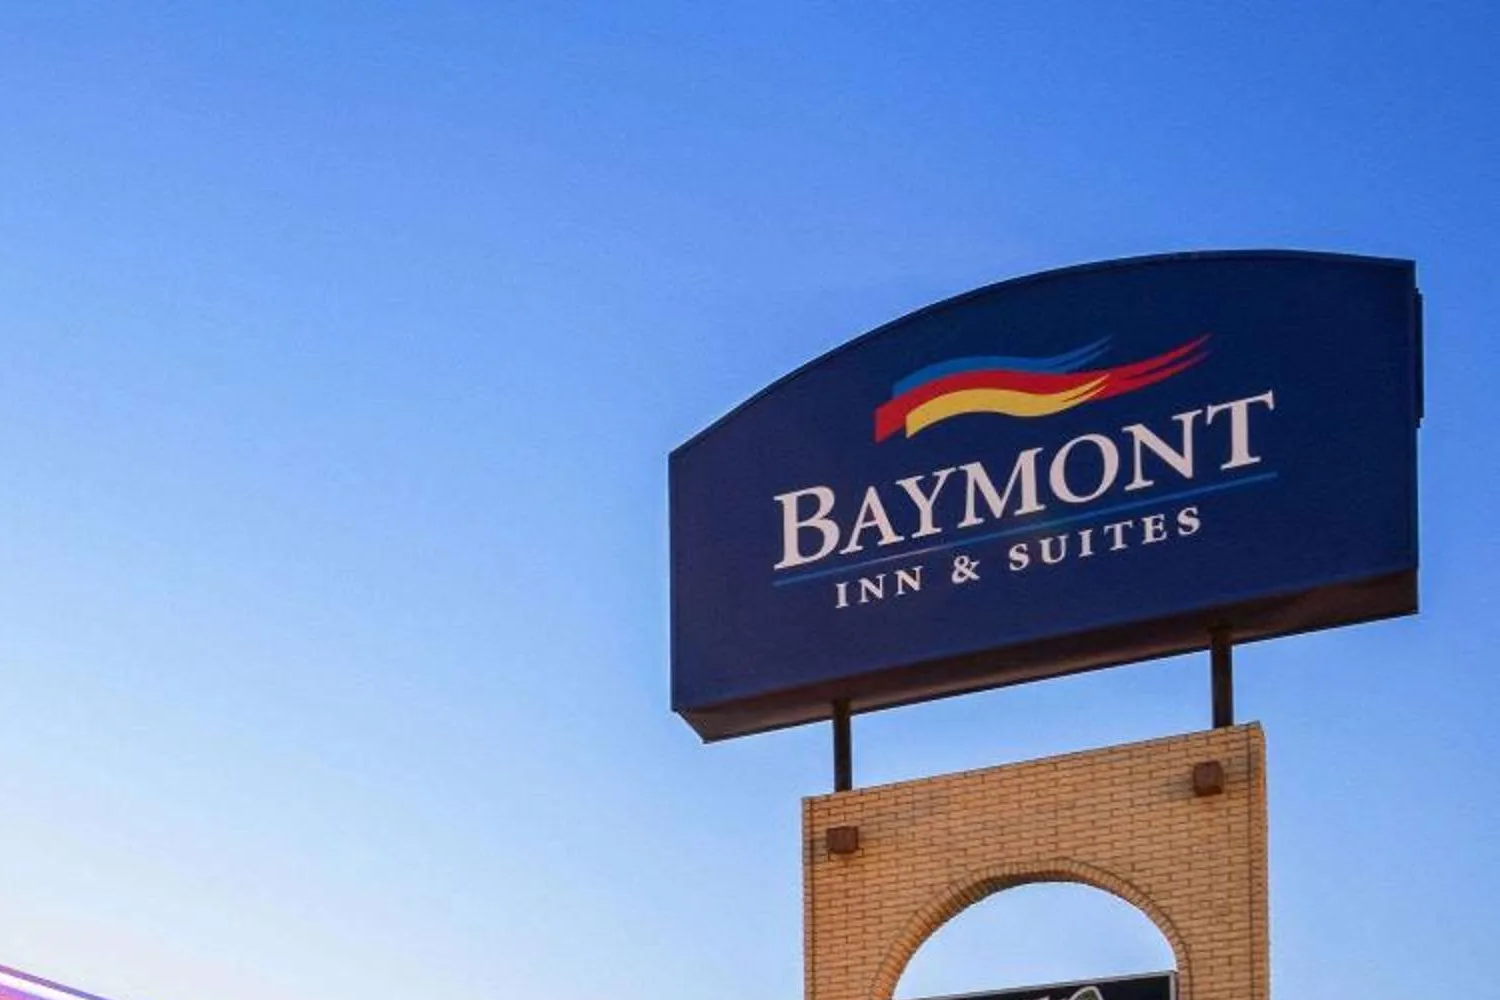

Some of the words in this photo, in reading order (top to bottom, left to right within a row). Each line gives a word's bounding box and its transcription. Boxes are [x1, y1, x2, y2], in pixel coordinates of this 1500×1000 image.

[773, 390, 1275, 570] BAYMONT
[835, 565, 924, 609] INN
[951, 555, 980, 584] &
[1008, 507, 1201, 571] SUITES
